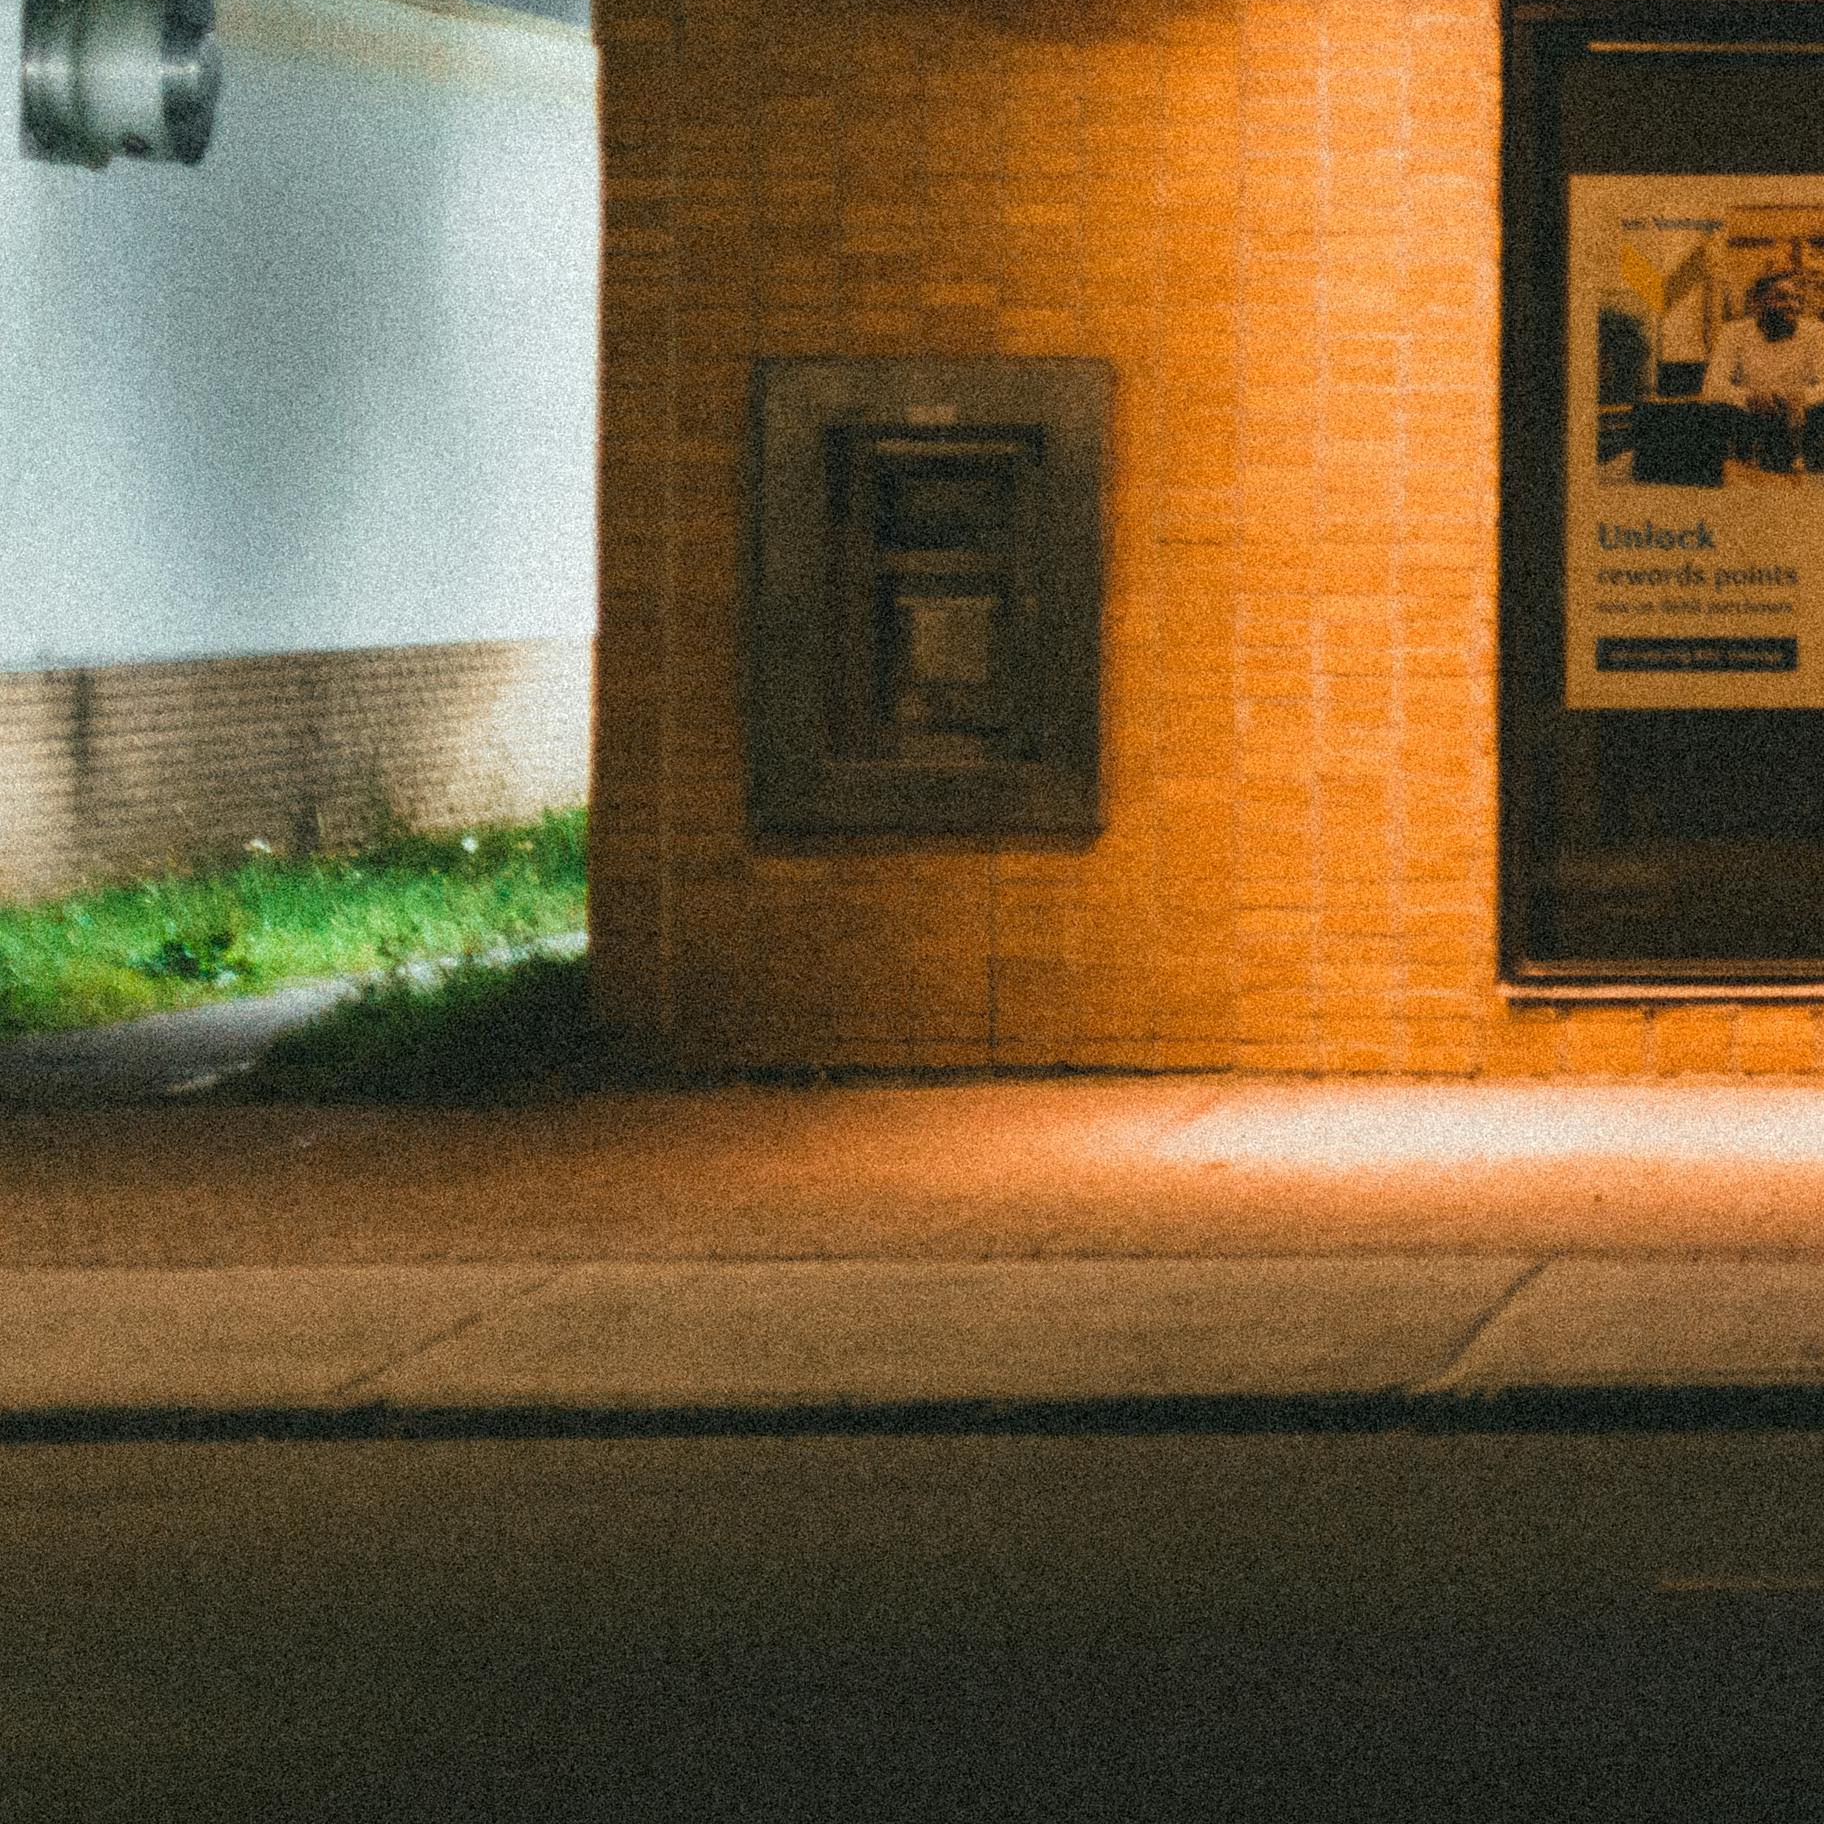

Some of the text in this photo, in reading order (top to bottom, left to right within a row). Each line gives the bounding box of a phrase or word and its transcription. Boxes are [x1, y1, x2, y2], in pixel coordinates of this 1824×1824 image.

[1596, 518, 1716, 551] Unlock
[1596, 561, 1799, 593] rewards points
